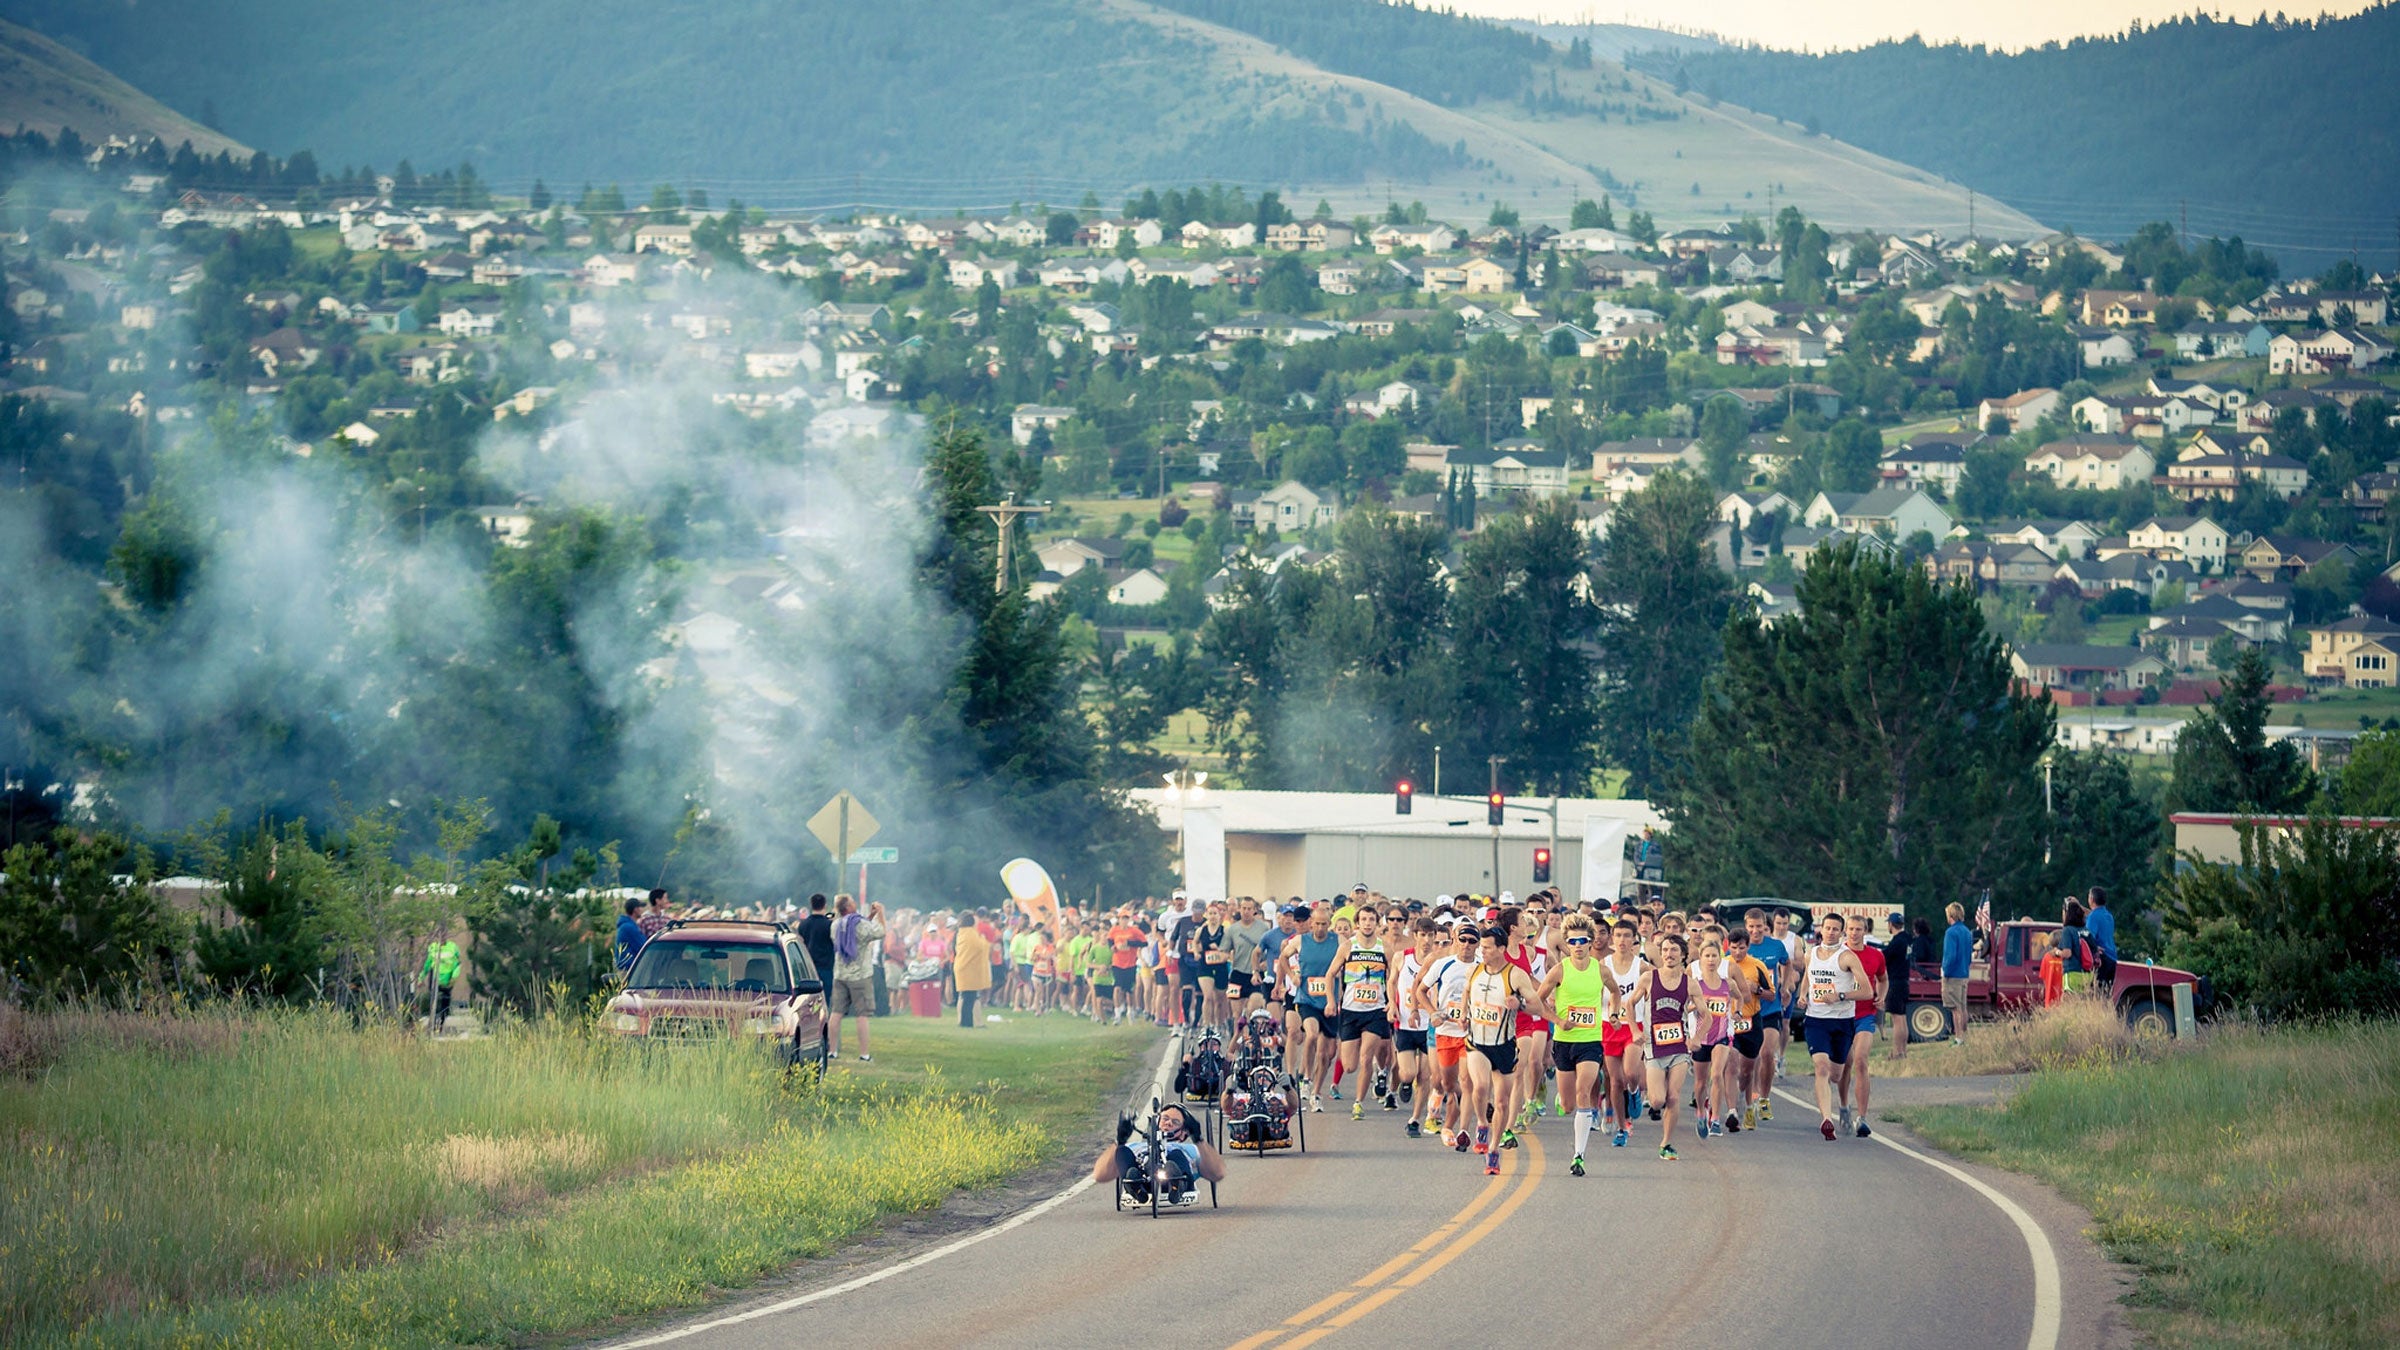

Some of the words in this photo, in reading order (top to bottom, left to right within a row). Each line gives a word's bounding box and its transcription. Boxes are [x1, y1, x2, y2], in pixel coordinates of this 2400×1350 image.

[1311, 982, 1326, 991] 319
[1356, 989, 1377, 999] 5750
[1570, 1012, 1593, 1024] 5780
[1658, 1028, 1680, 1040] 4755
